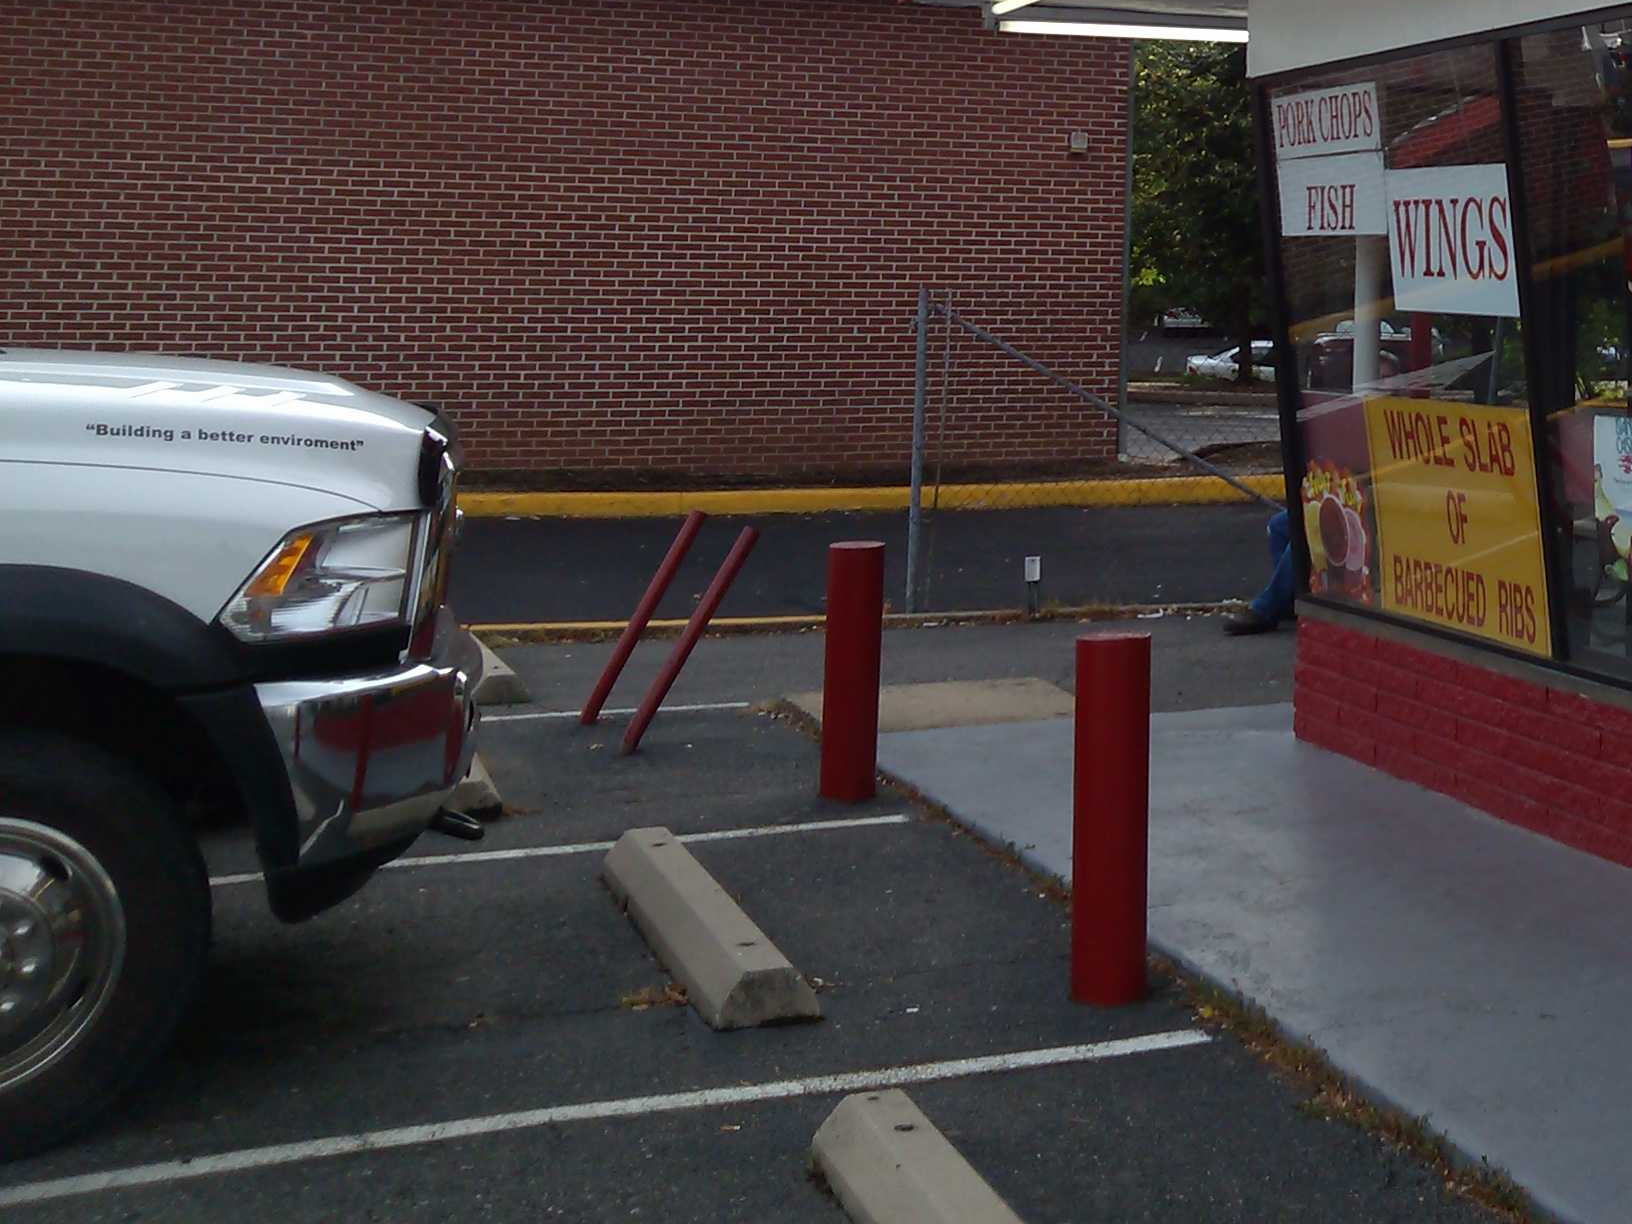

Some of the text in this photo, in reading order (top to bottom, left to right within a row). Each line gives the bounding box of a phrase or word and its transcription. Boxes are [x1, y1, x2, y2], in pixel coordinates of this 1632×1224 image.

[1276, 88, 1374, 149] PORK CHOPS
[1306, 183, 1356, 232] FISH
[1393, 196, 1510, 281] WINGS
[180, 429, 192, 440] a
[198, 428, 255, 444] better
[1383, 408, 1516, 477] WHOLE SLAB
[1446, 489, 1468, 546] OF
[1392, 553, 1537, 645] BARBECUED RIBS
